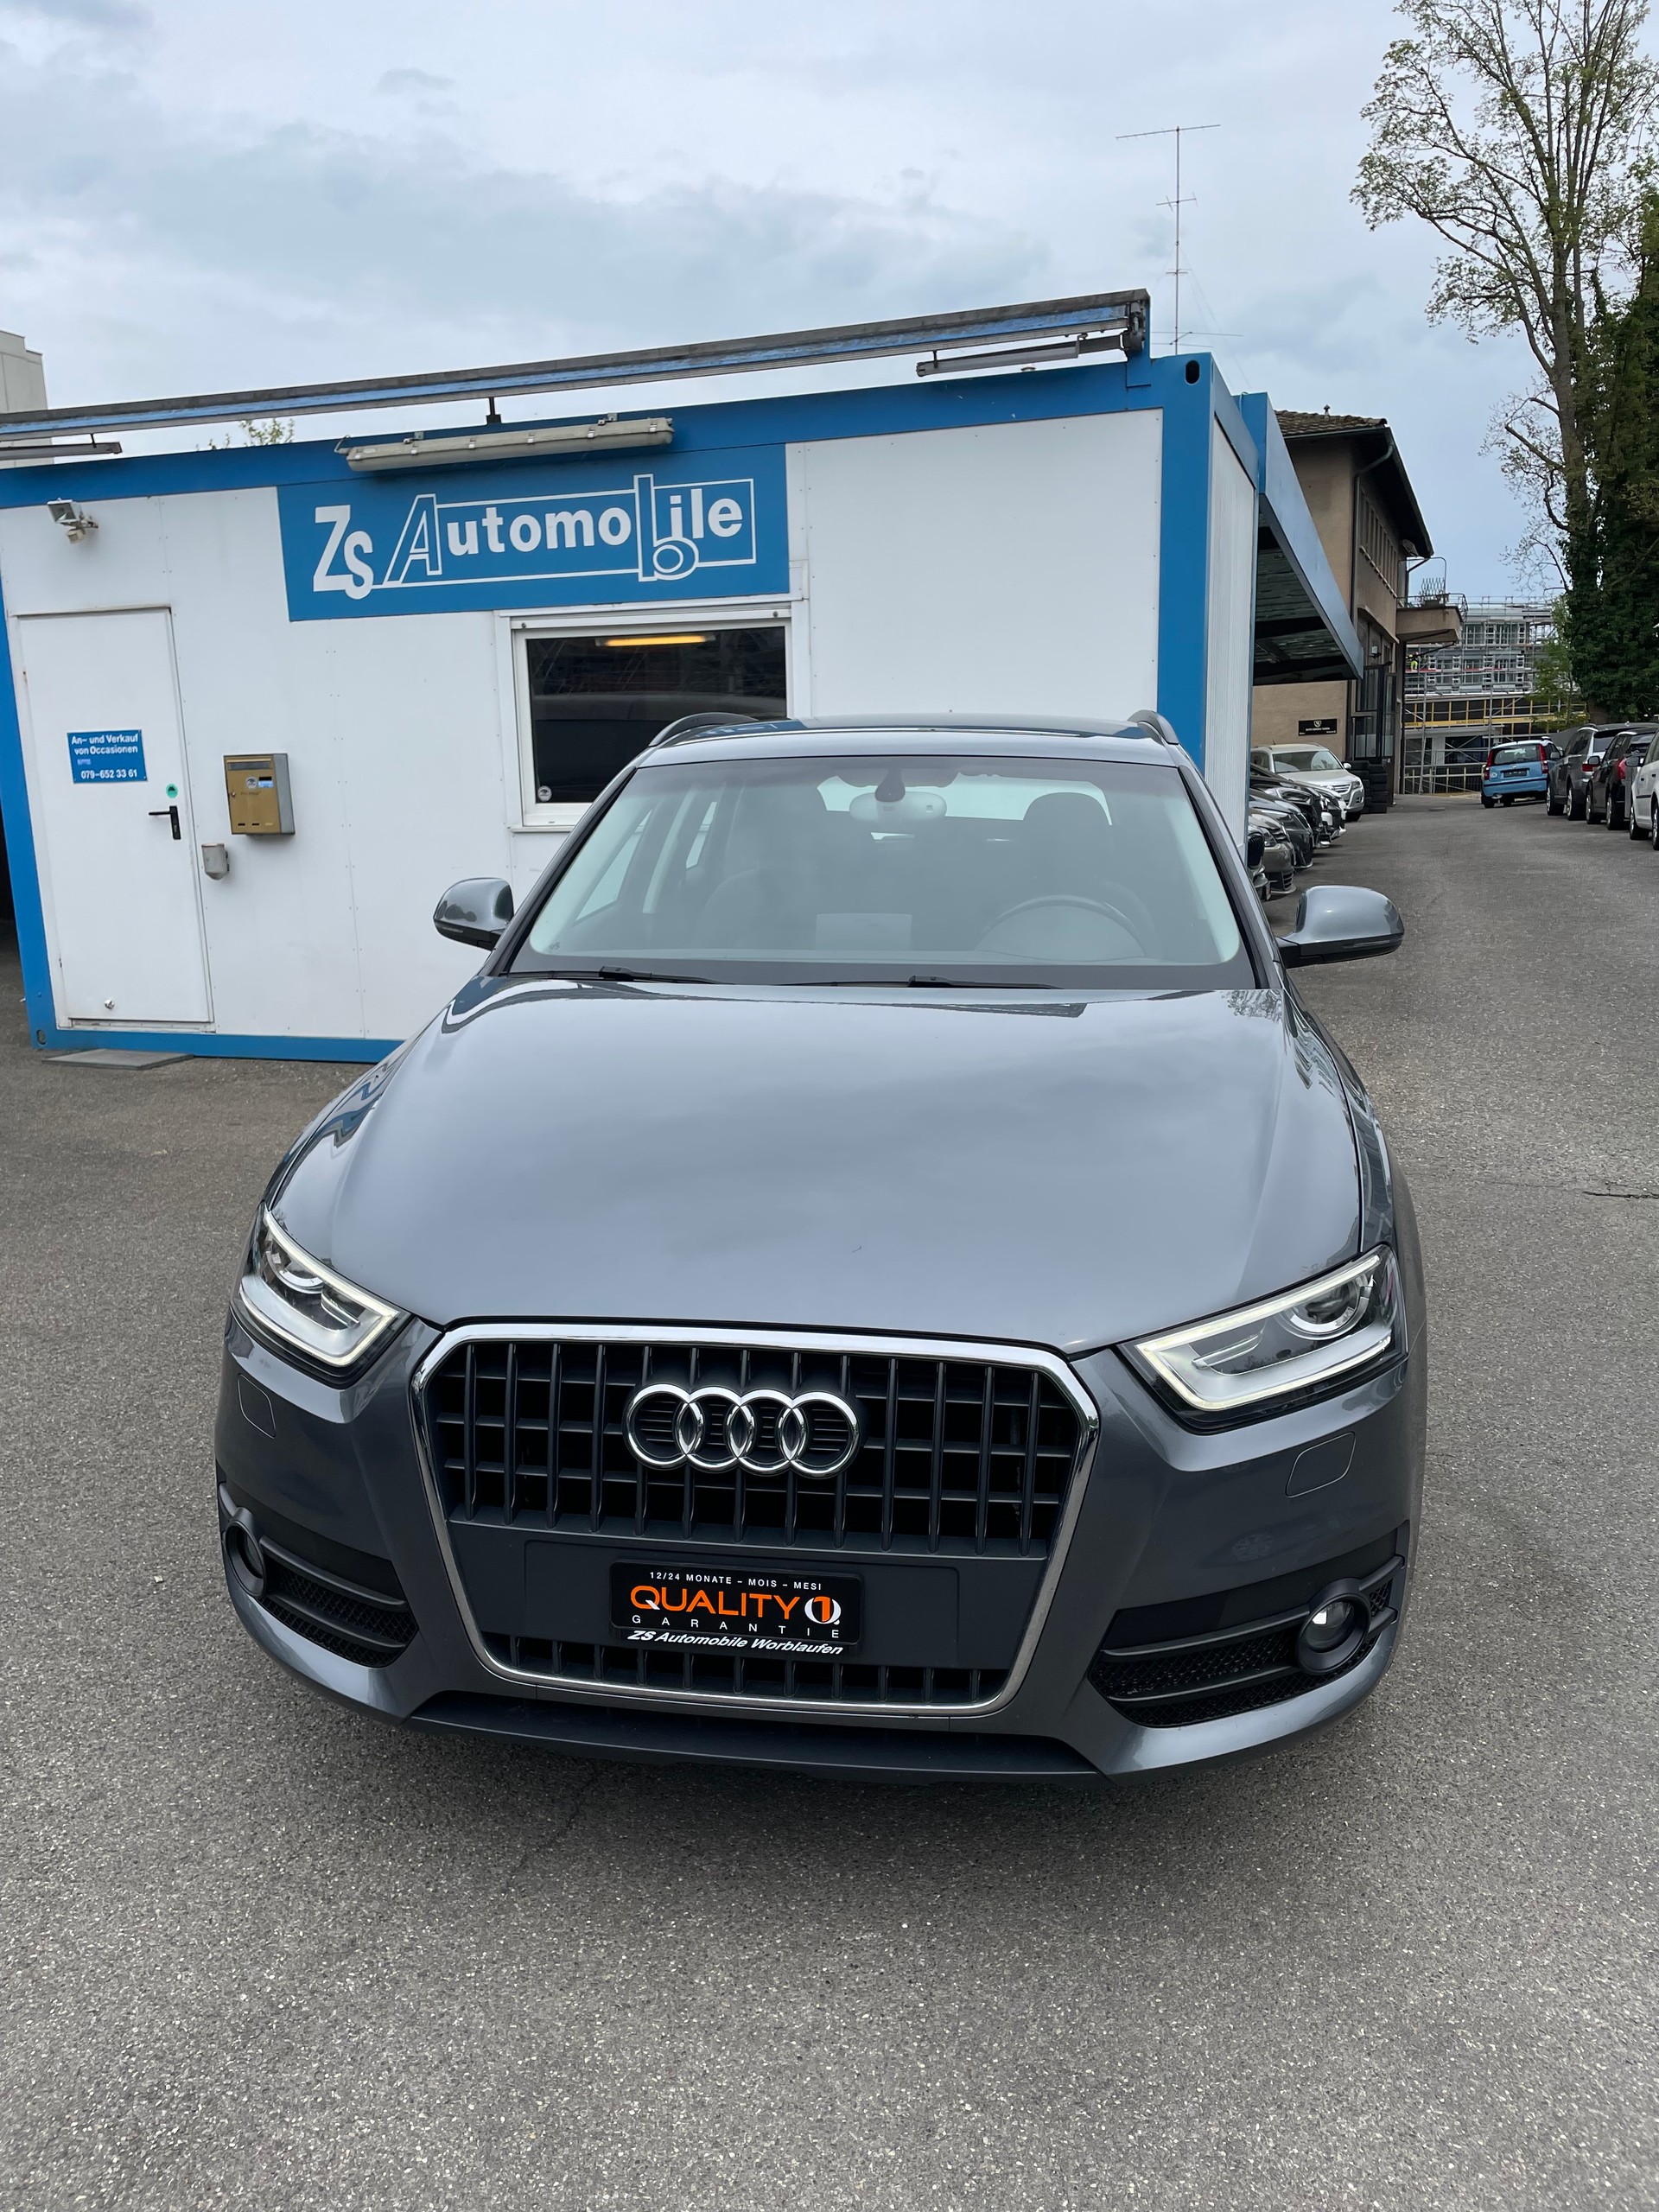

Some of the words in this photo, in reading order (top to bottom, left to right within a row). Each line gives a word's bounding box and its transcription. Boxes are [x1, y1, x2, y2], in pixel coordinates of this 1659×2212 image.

[383, 474, 744, 585] Automobile
[89, 734, 105, 745] und
[105, 733, 138, 744] Verkauf
[89, 745, 138, 755] Occasionen
[80, 769, 115, 779] 079-652
[116, 768, 127, 779] 33
[128, 768, 137, 778] 61
[650, 1571, 680, 1580] 12/24
[686, 1573, 732, 1585] MONATE
[748, 1578, 777, 1588] MOIS
[793, 1581, 822, 1591] MESI
[630, 1585, 801, 1620] QUALITY
[632, 1614, 839, 1638] GARANTIE
[626, 1630, 657, 1642] ZS
[655, 1631, 748, 1649] Automobile
[750, 1638, 843, 1656] Worblaufen
